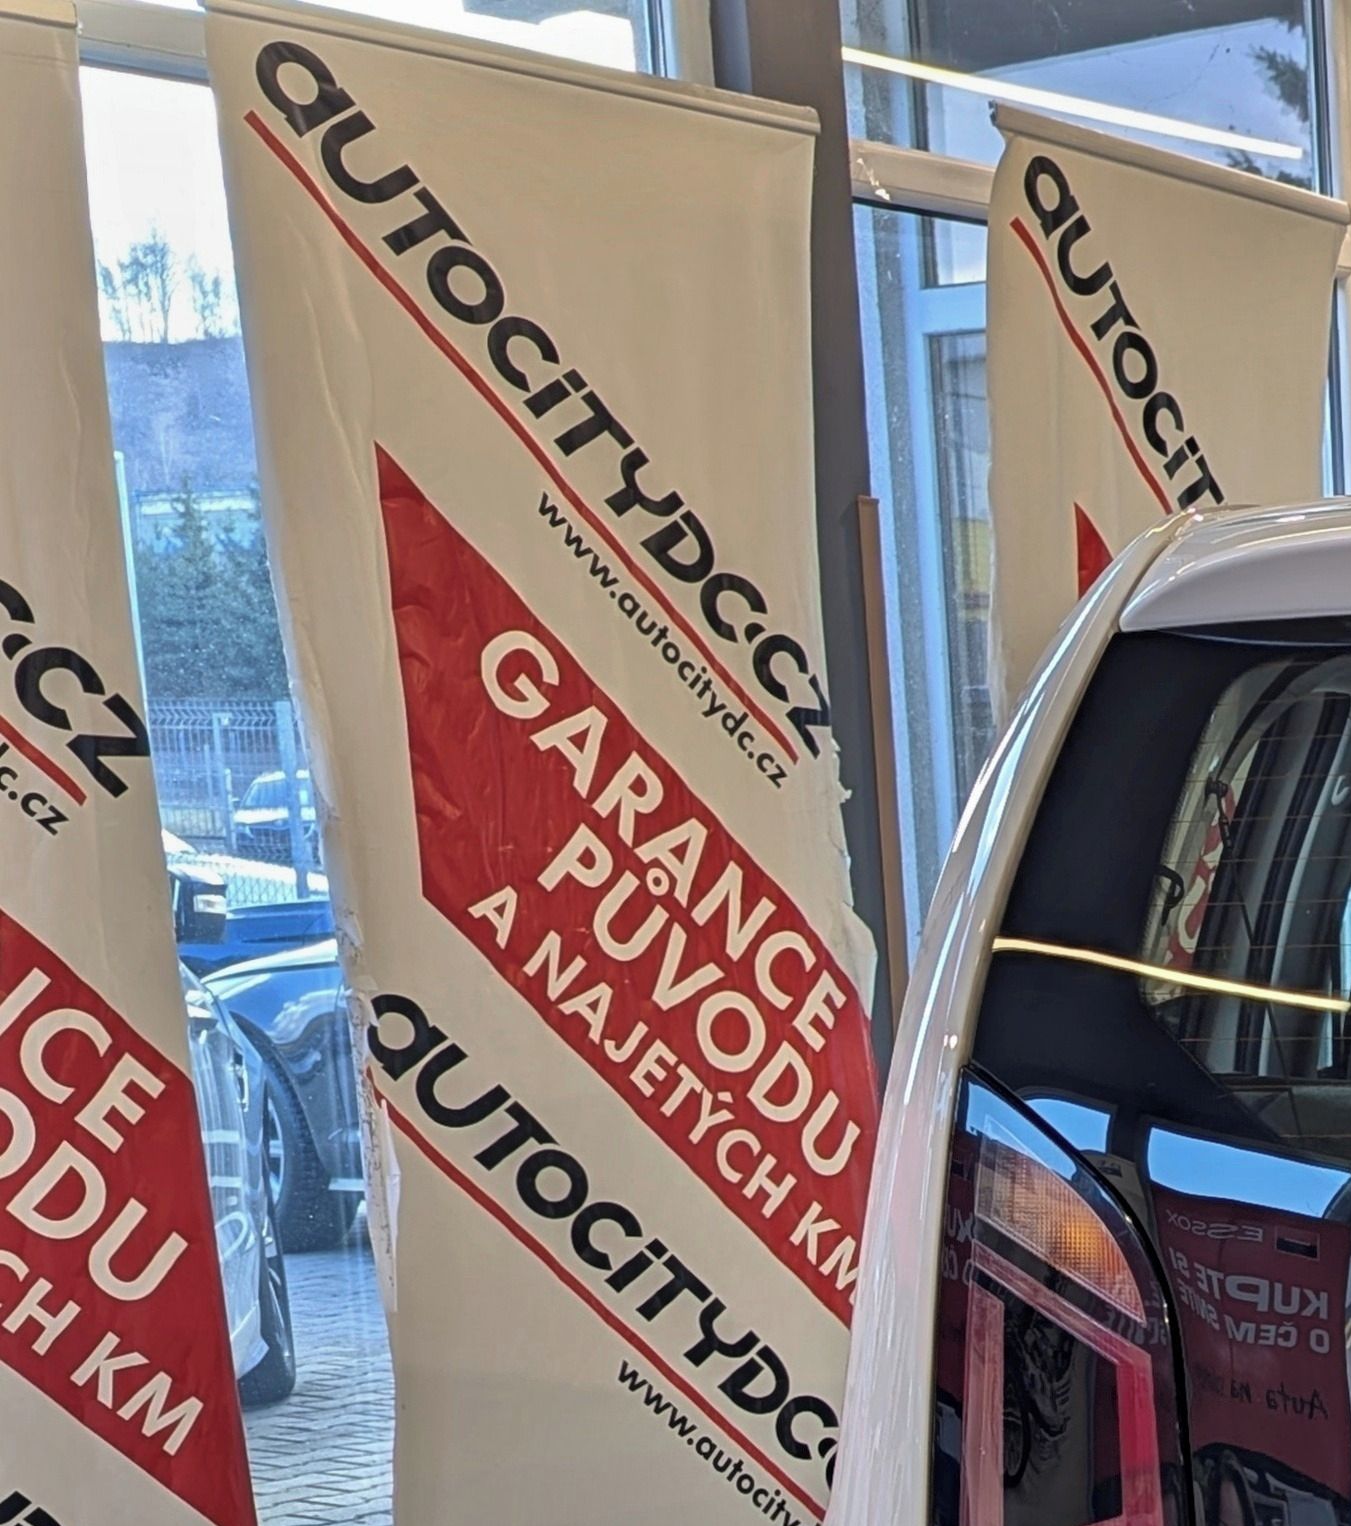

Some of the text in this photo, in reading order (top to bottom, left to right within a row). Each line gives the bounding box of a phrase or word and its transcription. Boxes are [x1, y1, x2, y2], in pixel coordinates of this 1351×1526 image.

[538, 492, 787, 789] www.autocitydc.cz
[480, 630, 848, 1052] GARANCE
[538, 822, 862, 1178] PŮVODU
[468, 885, 519, 949] A
[523, 930, 798, 1219] NAJETÝCH
[70, 1331, 205, 1456] KM
